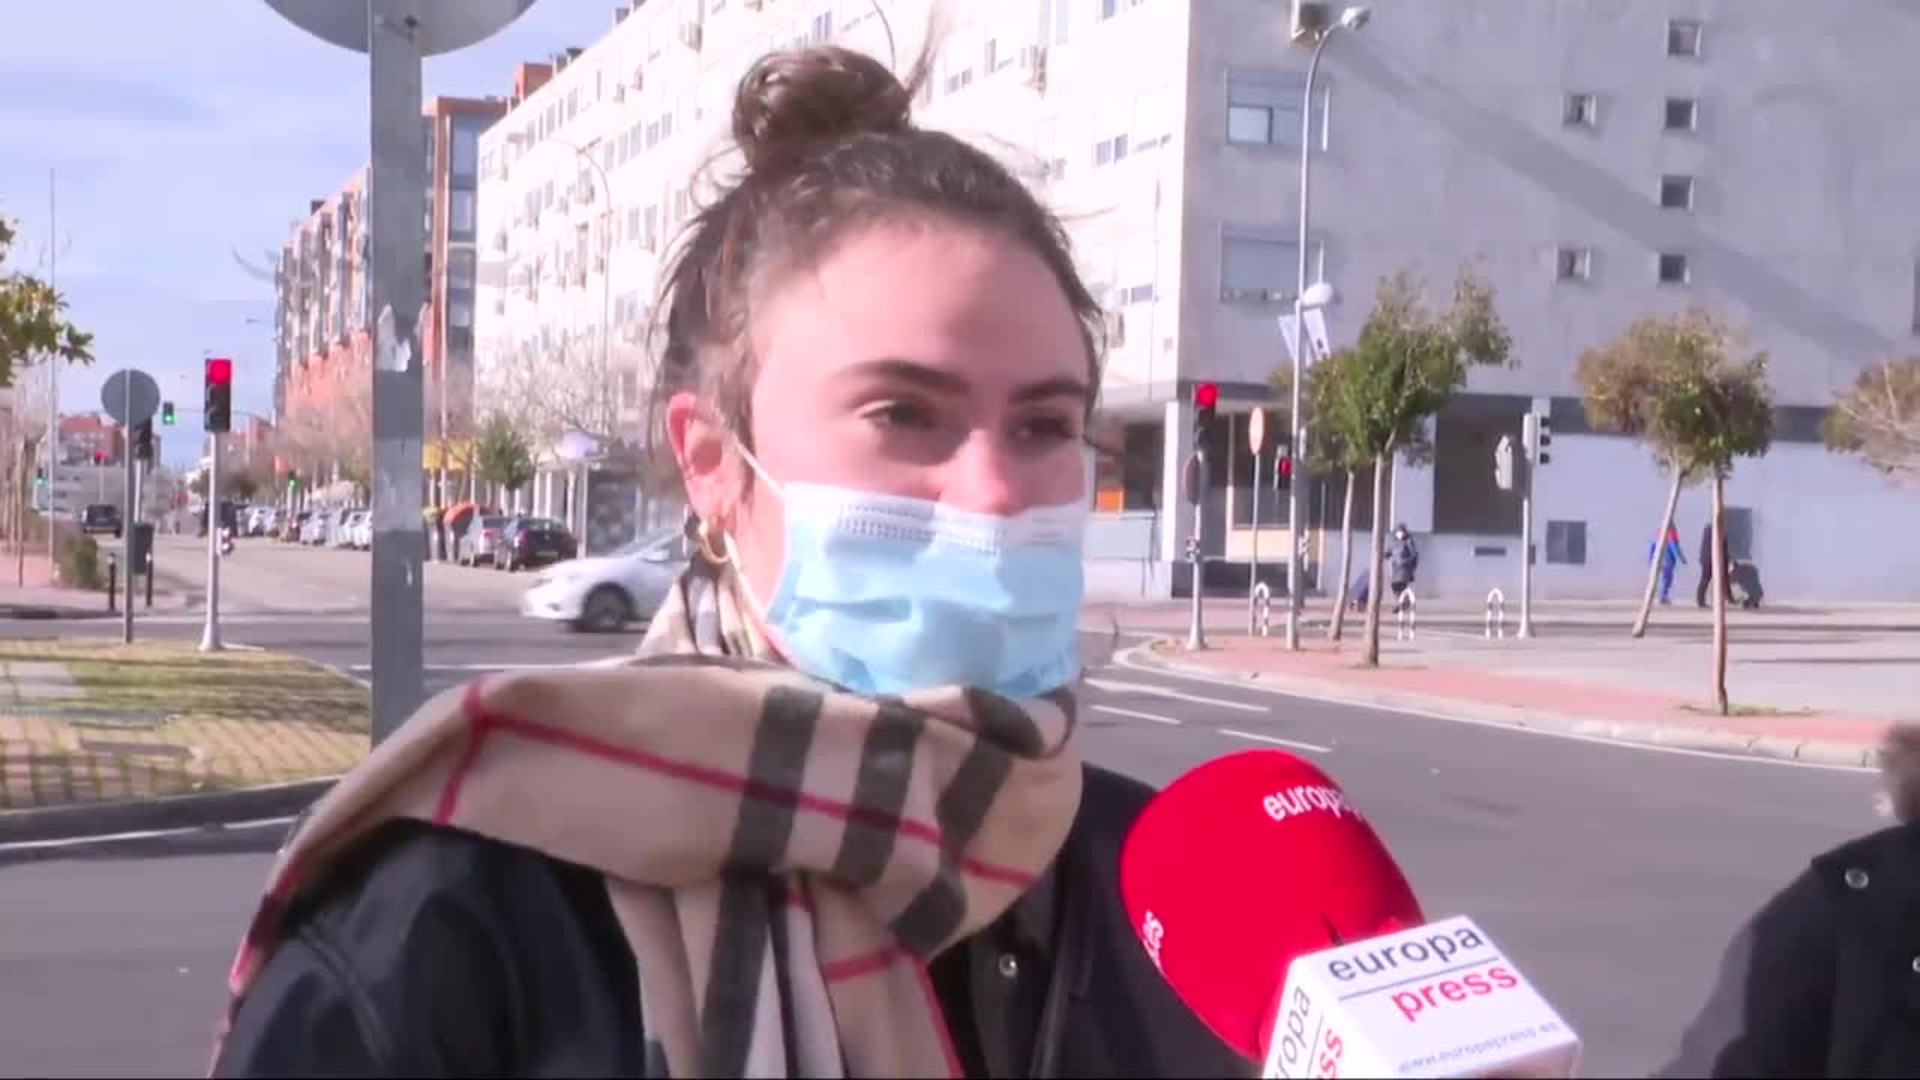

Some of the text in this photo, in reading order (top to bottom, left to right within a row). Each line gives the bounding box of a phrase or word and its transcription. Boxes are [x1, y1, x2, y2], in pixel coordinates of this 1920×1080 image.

[1263, 785, 1346, 823] europ
[1328, 927, 1484, 981] europa
[1391, 966, 1518, 1022] press
[1274, 985, 1311, 1078] ropa
